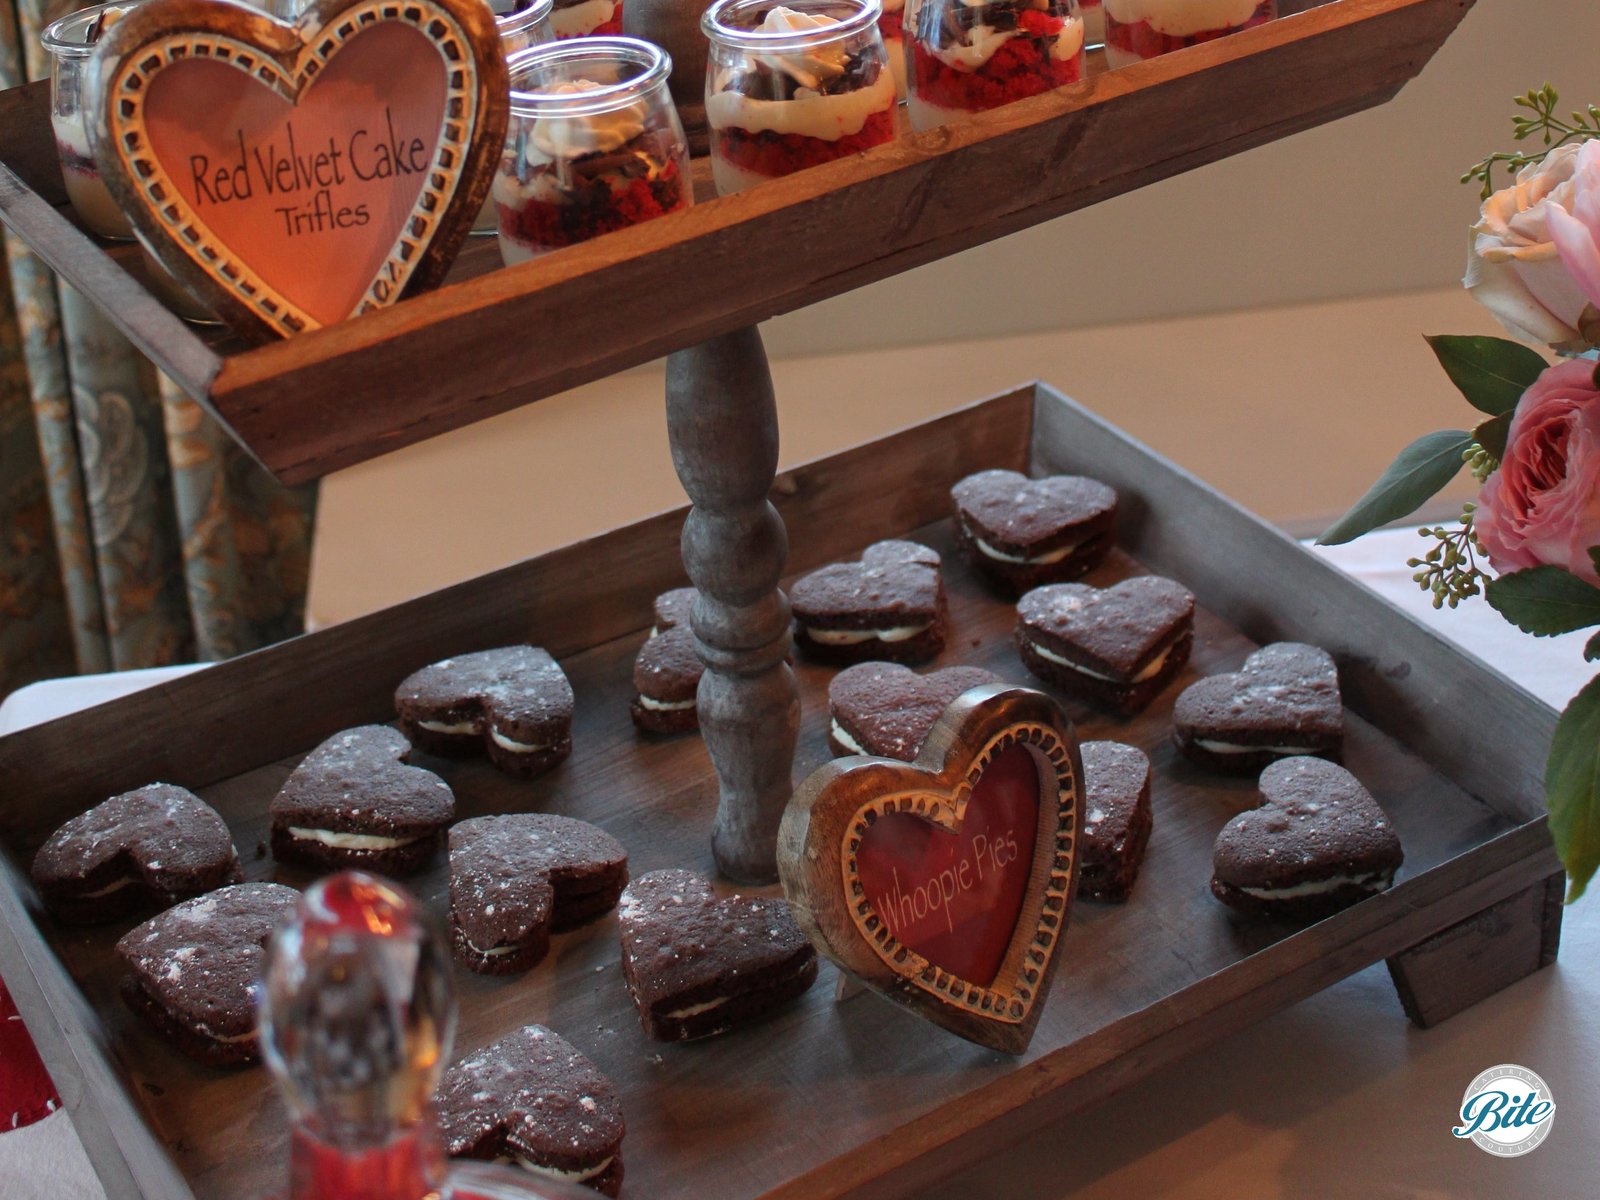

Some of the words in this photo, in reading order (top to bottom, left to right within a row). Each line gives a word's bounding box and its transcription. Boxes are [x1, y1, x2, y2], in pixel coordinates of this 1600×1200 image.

[190, 129, 252, 205] Red
[253, 121, 345, 196] Velvet
[349, 106, 428, 181] Cake
[275, 190, 370, 236] Trifles
[877, 848, 973, 933] Whoopie
[972, 826, 1018, 880] Pies
